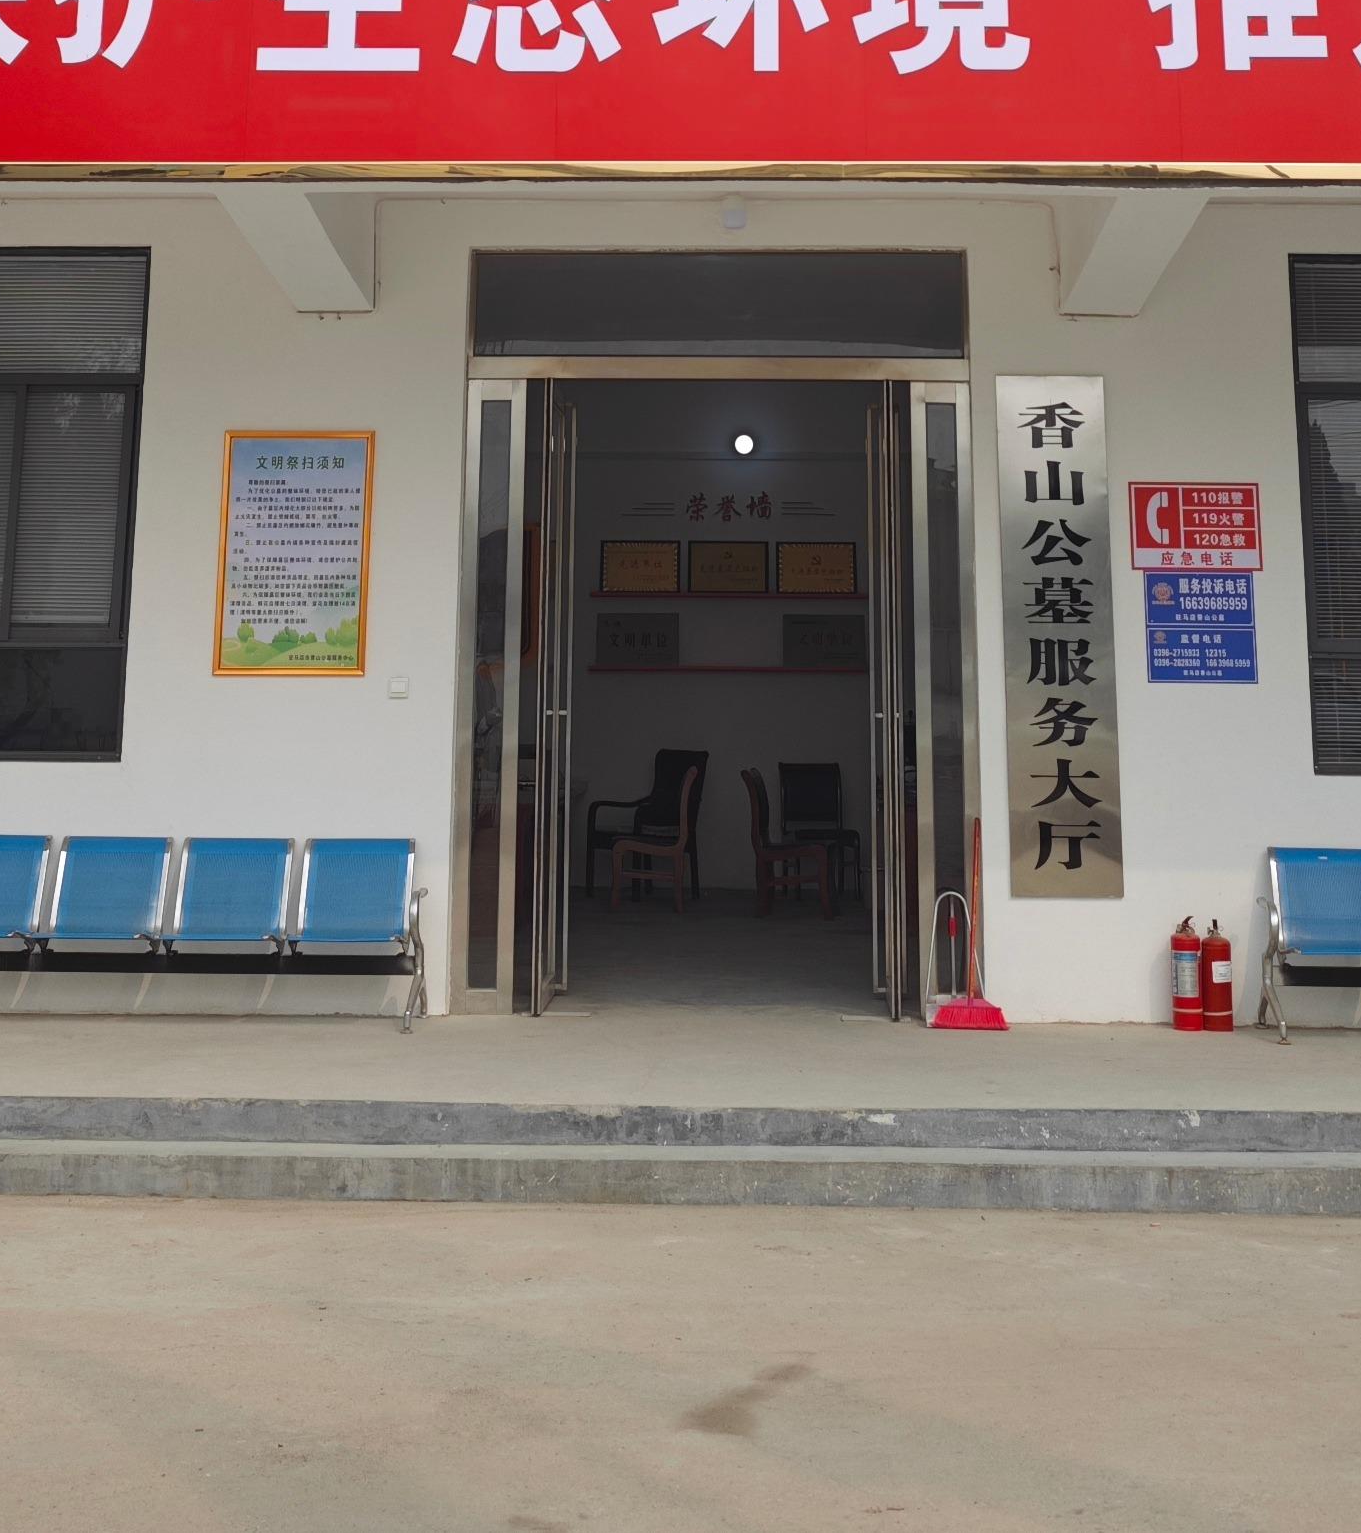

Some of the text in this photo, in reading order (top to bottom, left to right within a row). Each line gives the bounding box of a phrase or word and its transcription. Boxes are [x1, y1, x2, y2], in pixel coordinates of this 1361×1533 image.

[256, 455, 345, 470] 文明祭扫须知
[1191, 491, 1244, 505] 110报警
[685, 491, 774, 523] 荣誉墙
[1192, 513, 1245, 526] 119火警
[1193, 533, 1246, 547] 120急救
[1160, 551, 1234, 566] 应急电话
[1178, 578, 1247, 595] 服务投诉电话
[1179, 596, 1248, 611] 16639685959
[1017, 401, 1102, 871] 香山公墓服务大厅
